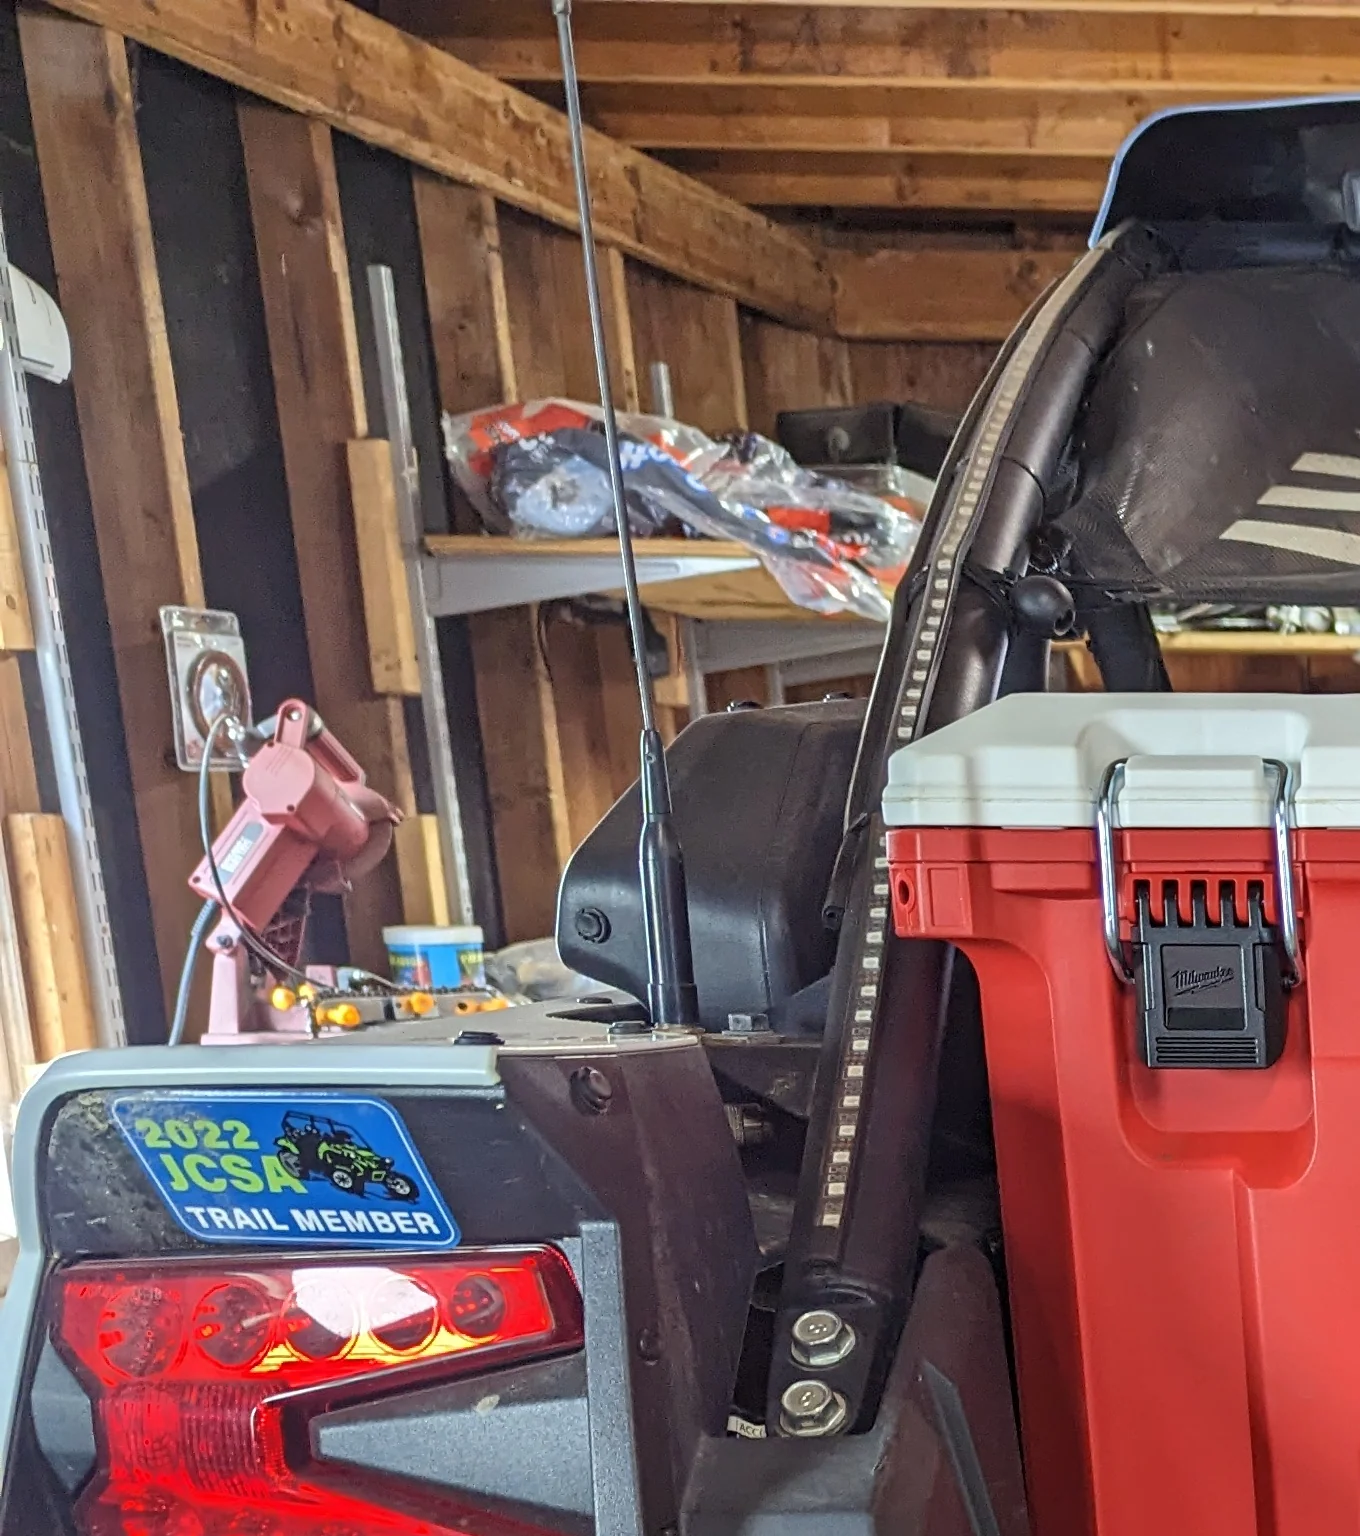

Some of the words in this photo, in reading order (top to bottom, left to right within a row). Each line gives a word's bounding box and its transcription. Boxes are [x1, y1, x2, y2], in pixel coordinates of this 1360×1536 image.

[135, 1118, 260, 1150] 2022
[160, 1153, 309, 1195] JCSA
[184, 1205, 290, 1232] TRAIL
[290, 1208, 441, 1235] MEMBER
